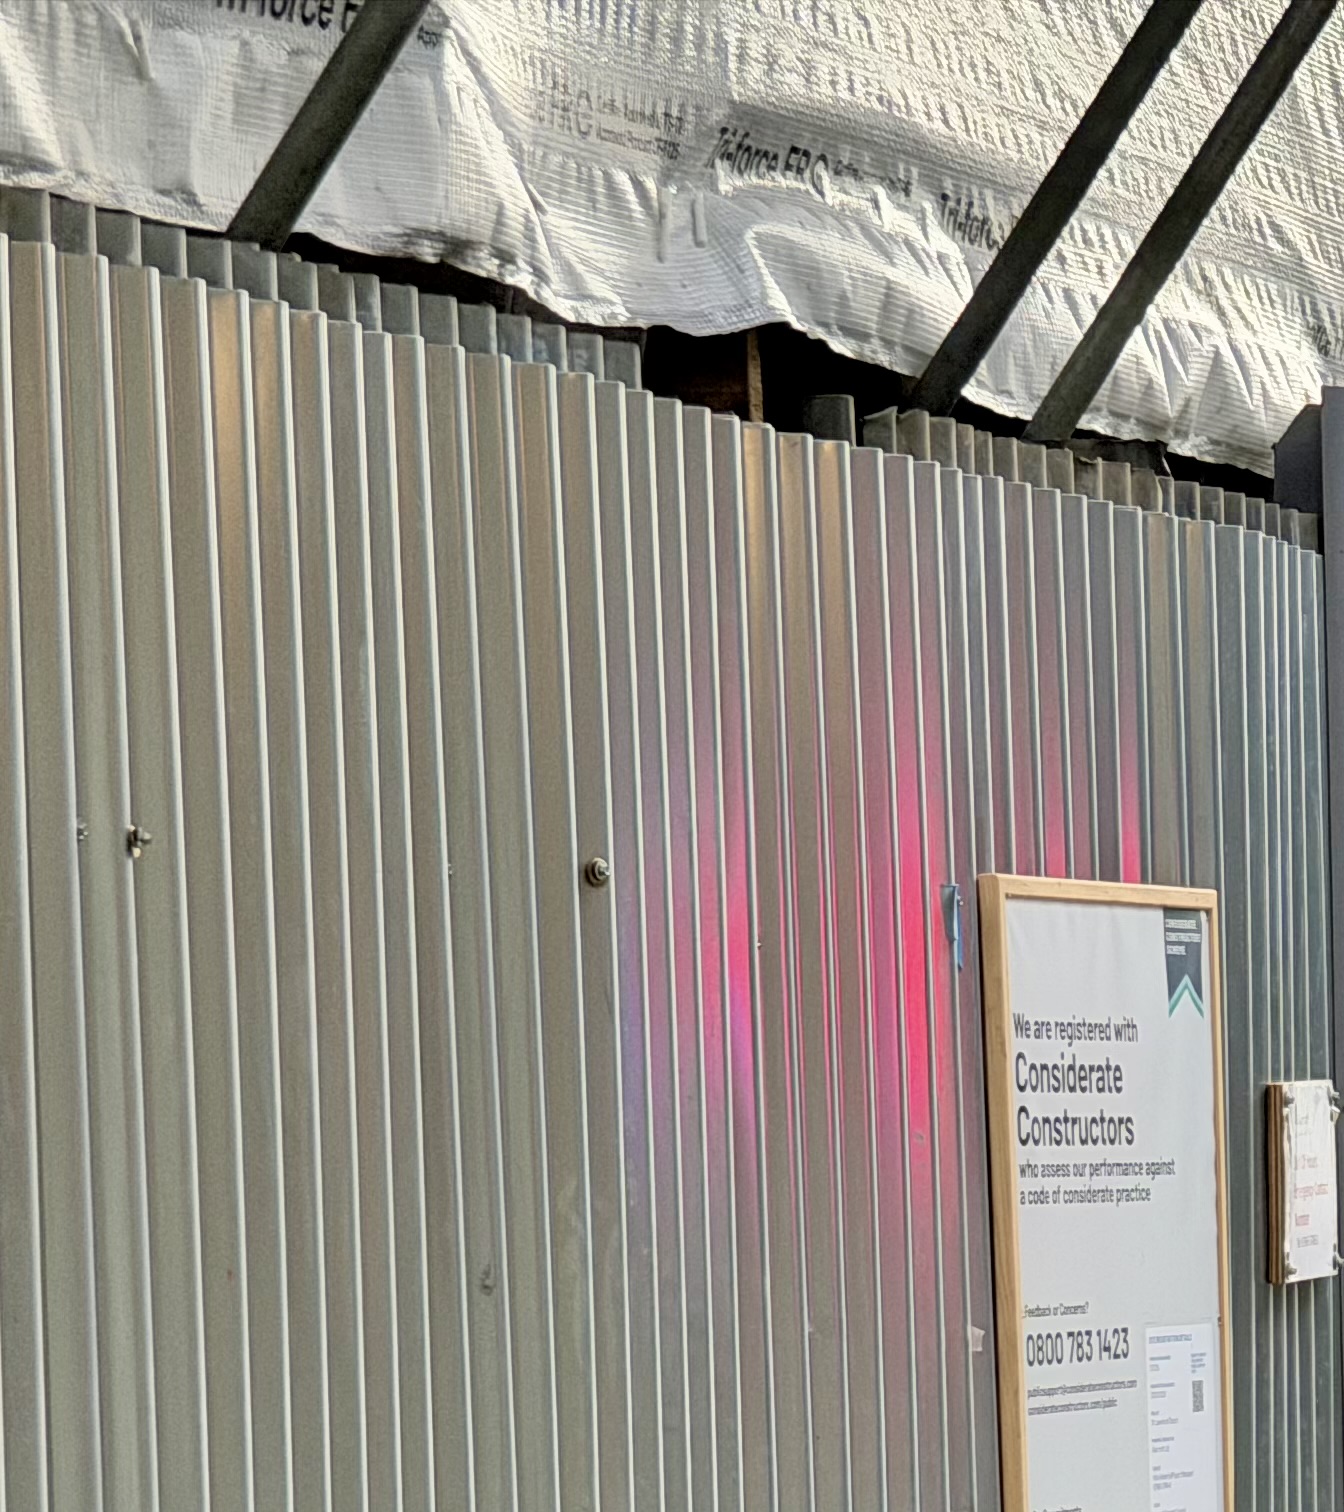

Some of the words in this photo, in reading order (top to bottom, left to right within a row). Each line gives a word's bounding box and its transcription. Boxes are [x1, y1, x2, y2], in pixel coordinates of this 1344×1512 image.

[1013, 1013, 1031, 1039] We
[1034, 1019, 1052, 1040] are
[1054, 1015, 1111, 1047] registered
[1113, 1016, 1138, 1043] with
[1015, 1051, 1124, 1094] Considerate
[1017, 1105, 1135, 1146] Constructors
[1019, 1159, 1039, 1179] who
[1041, 1162, 1071, 1178] assess
[1073, 1161, 1087, 1178] our
[1089, 1158, 1144, 1181] performance
[1145, 1157, 1176, 1180] against
[1020, 1190, 1026, 1205] a
[1028, 1185, 1050, 1205] code
[1052, 1185, 1061, 1205] of
[1063, 1184, 1114, 1205] considerate
[1116, 1183, 1151, 1207] practice
[1026, 1331, 1064, 1367] 0800
[1067, 1330, 1094, 1363] 783
[1096, 1326, 1130, 1361] 1423
